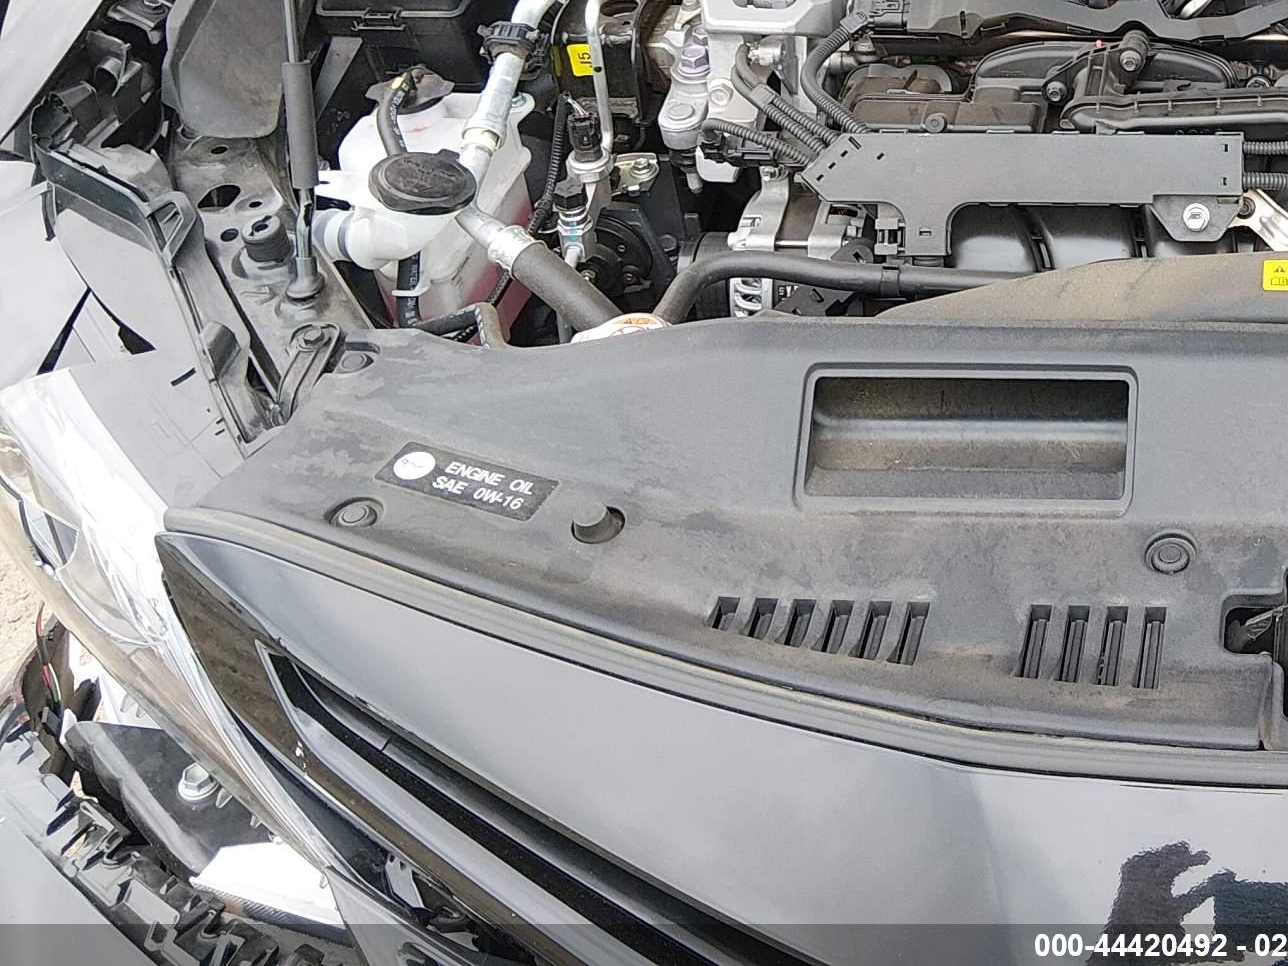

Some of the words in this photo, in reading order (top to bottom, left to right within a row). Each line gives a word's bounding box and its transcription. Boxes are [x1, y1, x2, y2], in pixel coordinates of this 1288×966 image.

[431, 476, 469, 495] SAE
[473, 487, 524, 510] 0W-16
[445, 461, 505, 486] ENGINE
[508, 479, 536, 495] OIL
